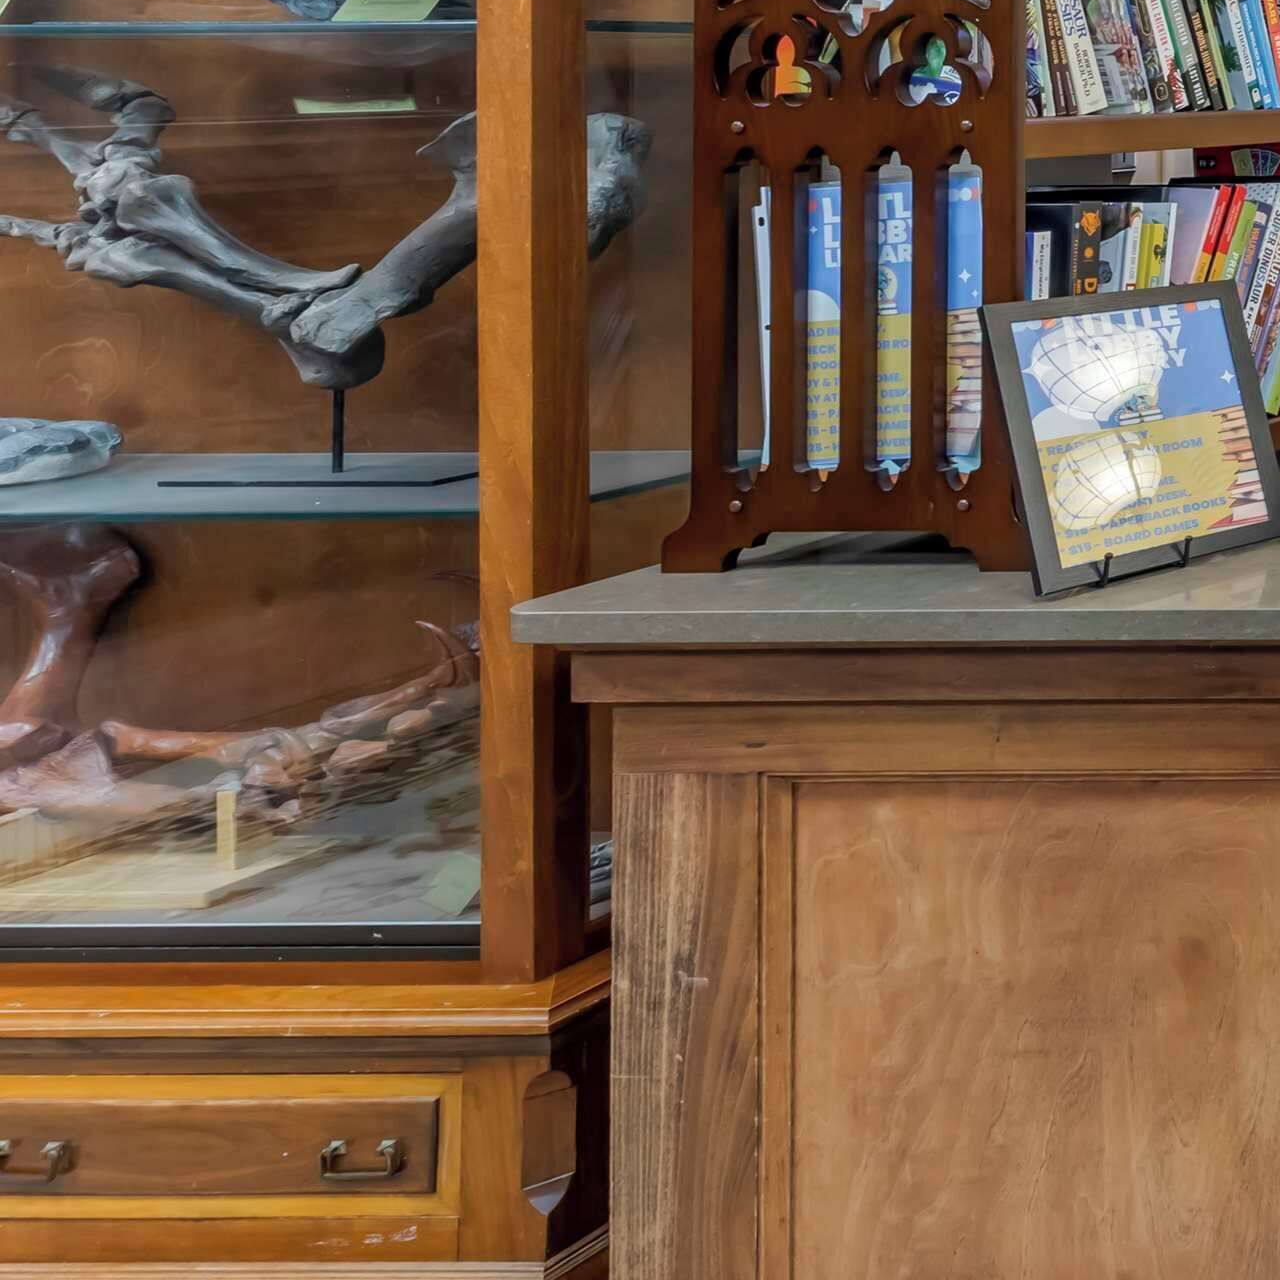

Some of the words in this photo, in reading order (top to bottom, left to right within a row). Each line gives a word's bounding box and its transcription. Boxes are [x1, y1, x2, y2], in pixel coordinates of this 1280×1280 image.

[1191, 13, 1202, 29] THE
[1195, 30, 1208, 50] BONE
[1201, 51, 1217, 86] HUNTERS
[1248, 246, 1274, 304] DINOSAUR
[1162, 437, 1204, 453] ROOM
[1101, 509, 1180, 531] PAPERBACK
[1183, 496, 1227, 512] BOOKS
[1104, 529, 1151, 547] BOARD
[1155, 519, 1200, 536] GAMES
